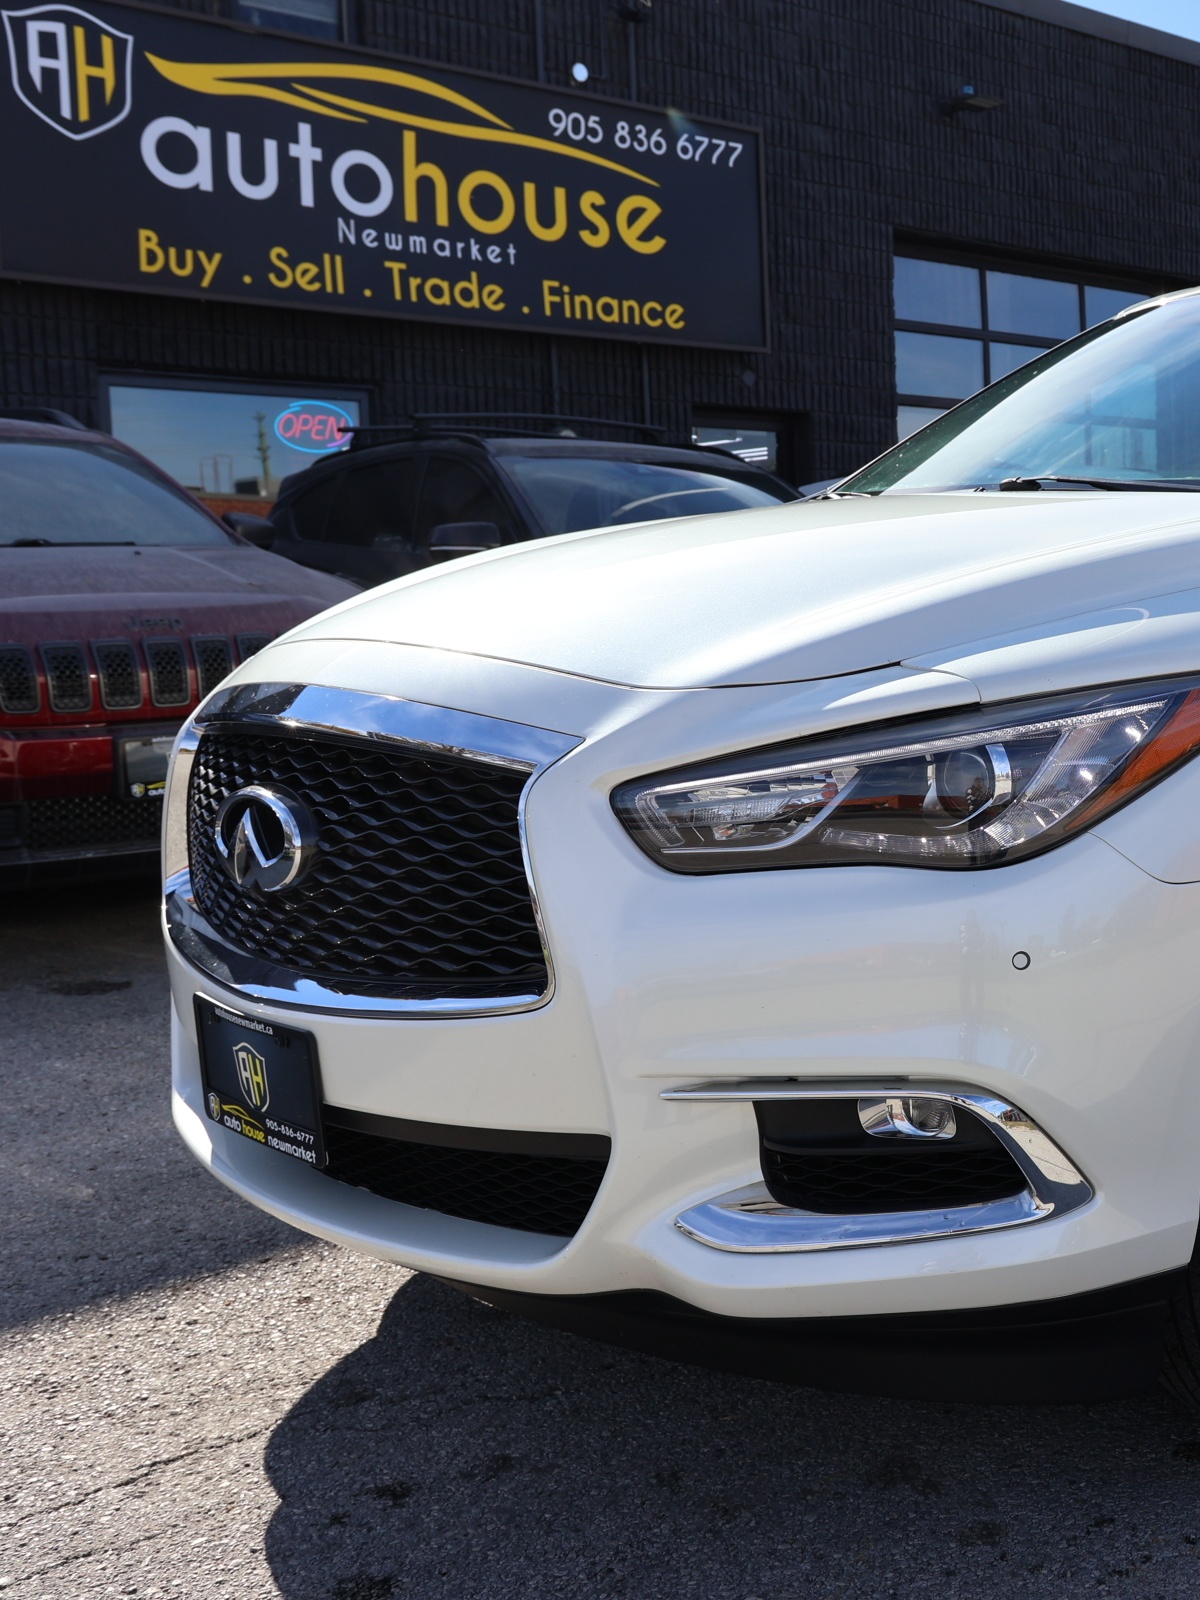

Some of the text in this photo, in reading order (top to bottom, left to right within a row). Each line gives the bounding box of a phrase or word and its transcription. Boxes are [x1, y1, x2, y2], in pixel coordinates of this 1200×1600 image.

[26, 20, 116, 122] AH
[548, 108, 743, 168] 905 836 6777
[140, 116, 667, 255] autohouse
[337, 217, 517, 266] Newmarket
[138, 228, 222, 288] Buy
[269, 246, 345, 294] Sell
[384, 261, 506, 311] Trade
[543, 279, 686, 330] Finance
[279, 413, 346, 441] OPEN
[265, 1118, 314, 1145] 905-836-6777
[267, 1135, 317, 1164] newmarket
